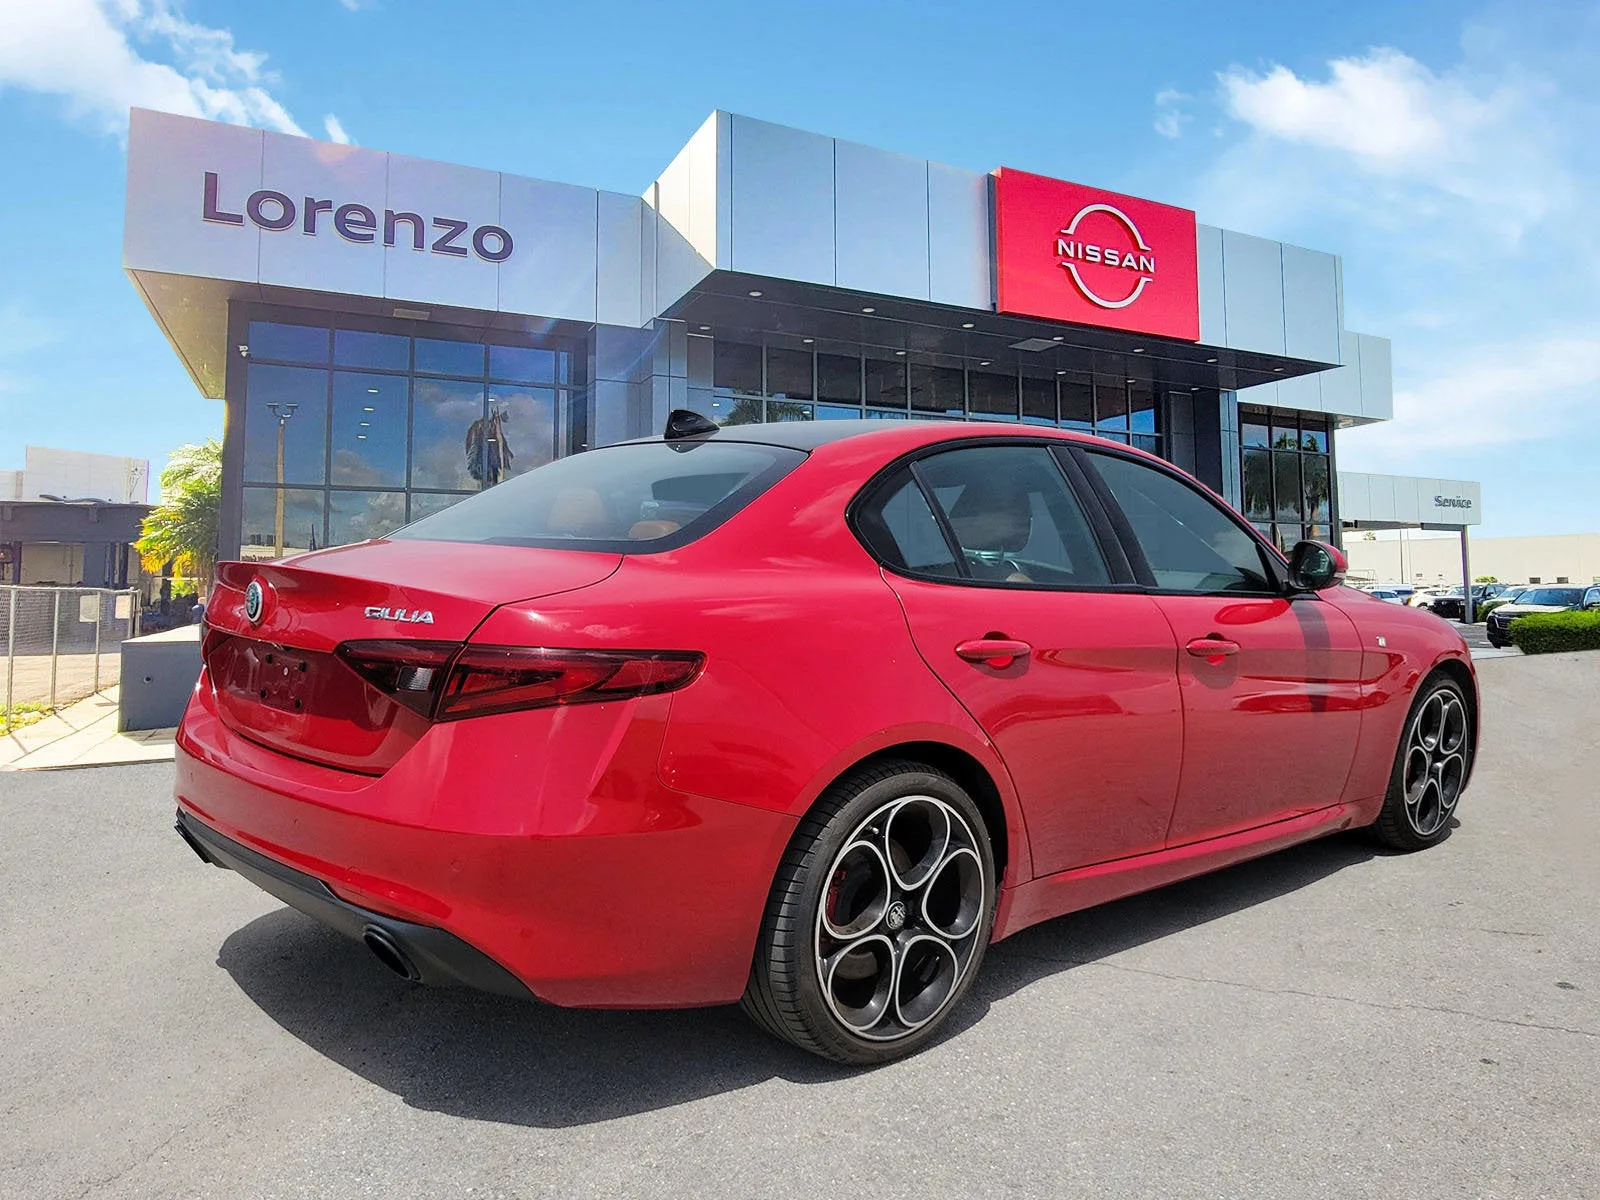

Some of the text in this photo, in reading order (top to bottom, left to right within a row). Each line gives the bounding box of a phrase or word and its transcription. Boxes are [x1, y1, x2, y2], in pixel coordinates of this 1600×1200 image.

[202, 171, 515, 263] Lorenzo
[1057, 238, 1155, 273] NISSAN
[1434, 495, 1472, 508] Service
[364, 606, 434, 624] GIULIA
